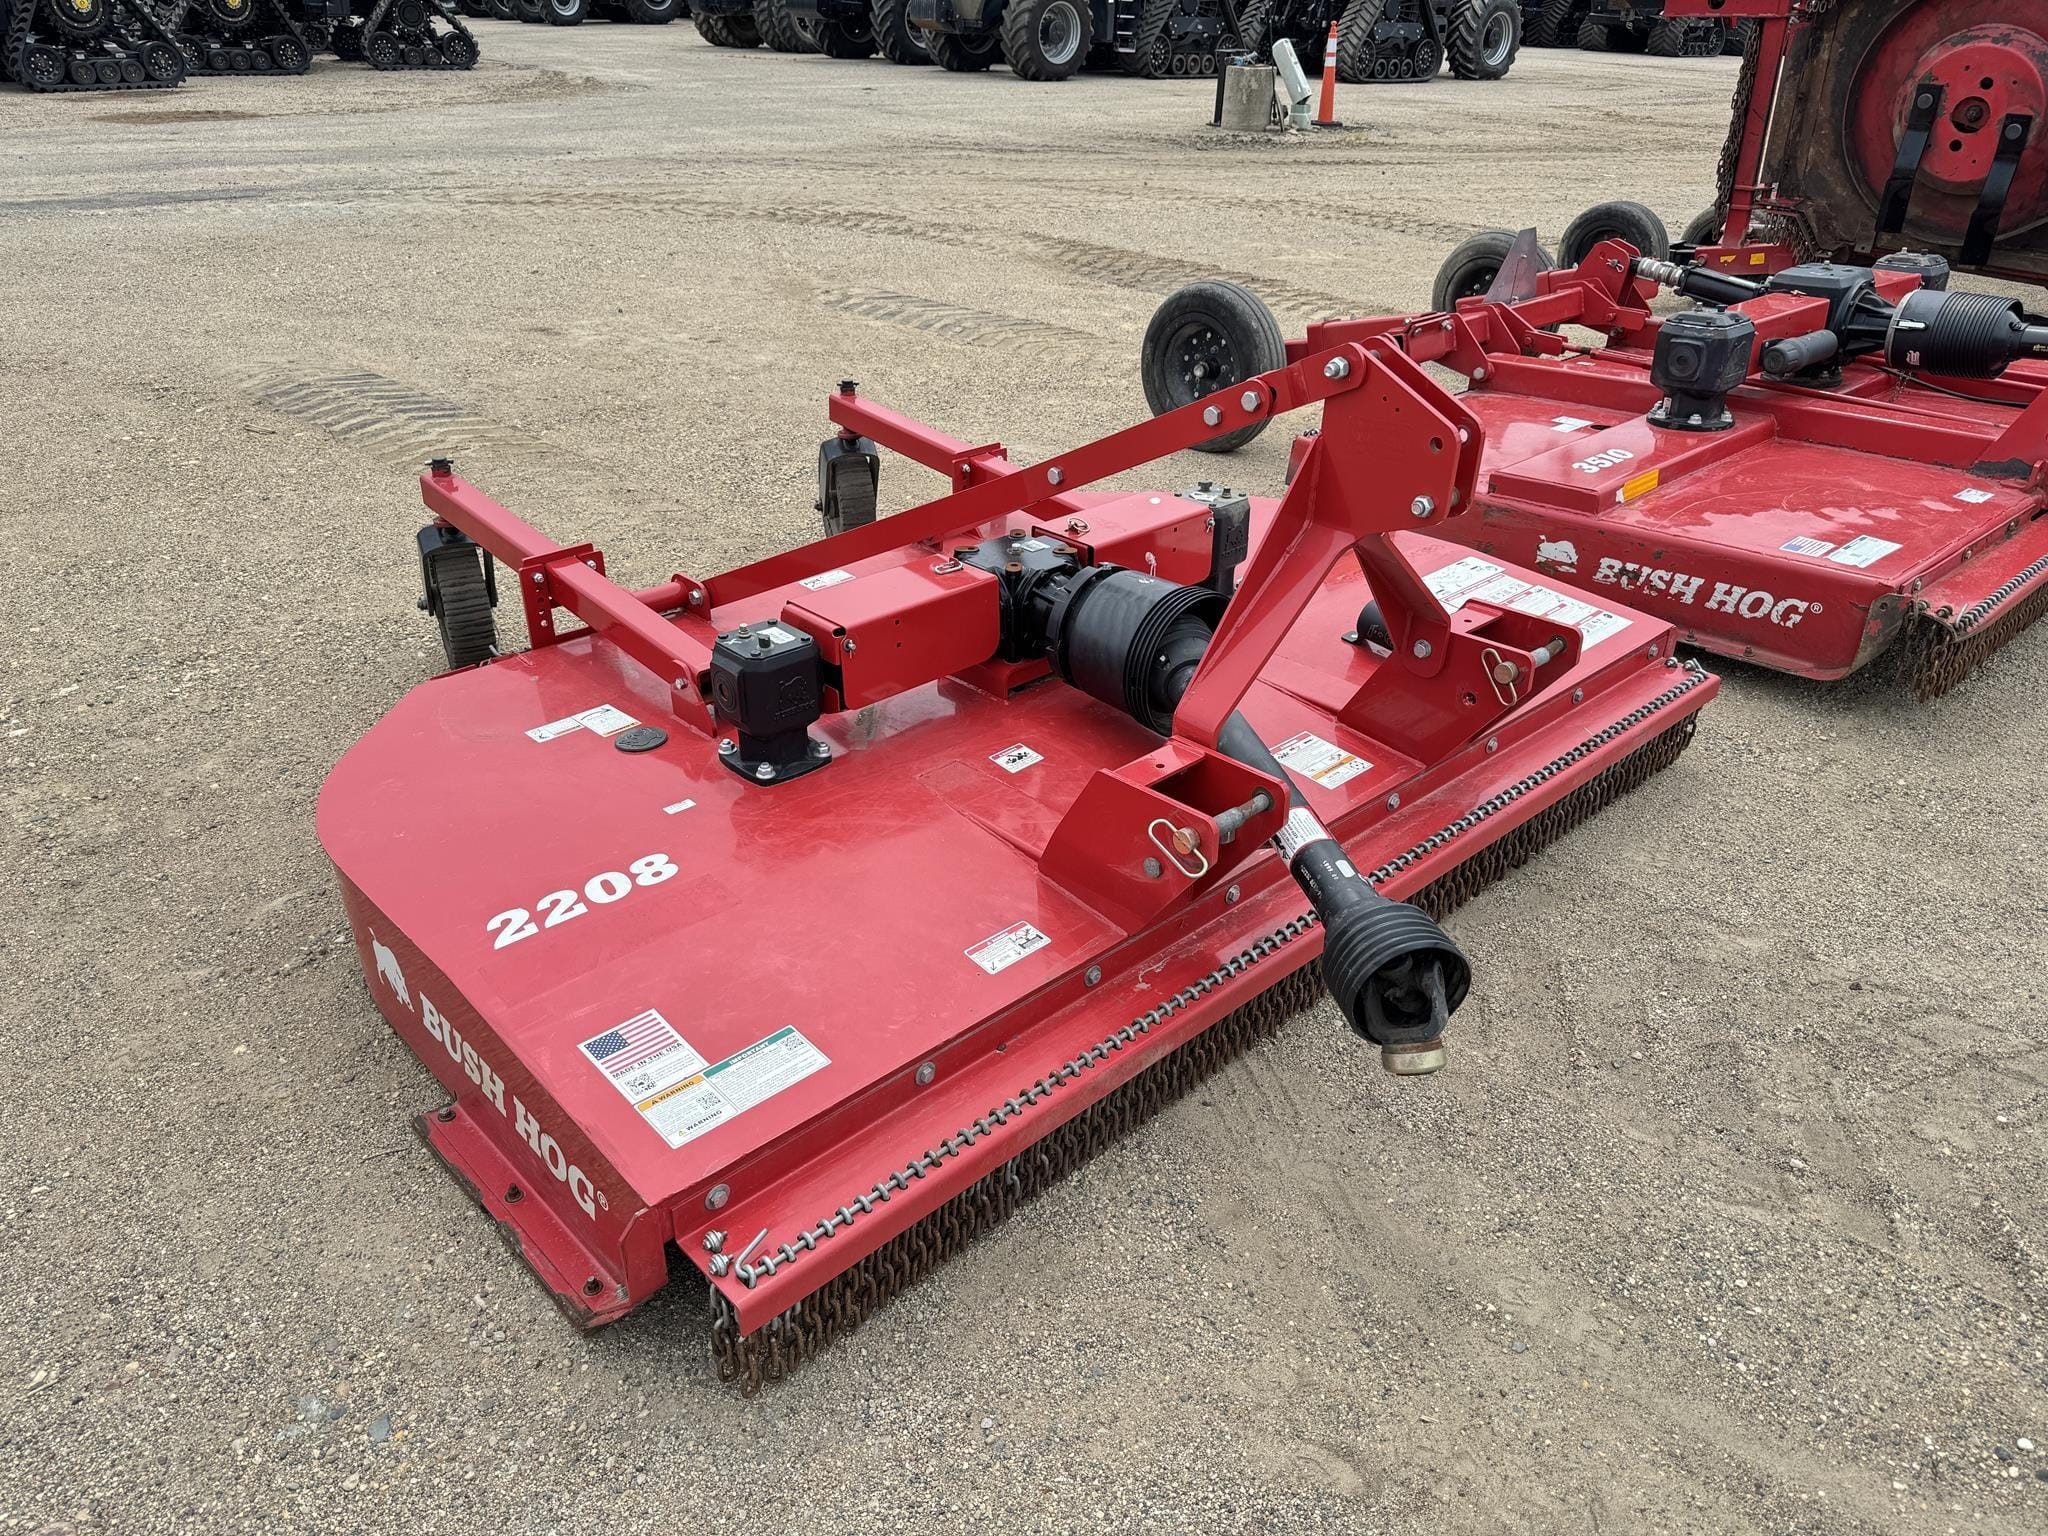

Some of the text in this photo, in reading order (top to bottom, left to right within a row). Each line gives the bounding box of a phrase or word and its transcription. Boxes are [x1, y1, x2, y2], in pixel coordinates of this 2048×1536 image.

[1571, 448, 1634, 474] 3510
[1592, 557, 1705, 605] BUSH
[487, 853, 679, 950] 2208
[419, 991, 507, 1118] BUSH
[612, 1065, 635, 1079] MADE
[647, 1051, 664, 1061] THE
[665, 1042, 682, 1053] USA
[728, 1041, 770, 1065] IMPORTANT
[659, 1081, 694, 1100] WARNING
[686, 1110, 722, 1131] WARNING
